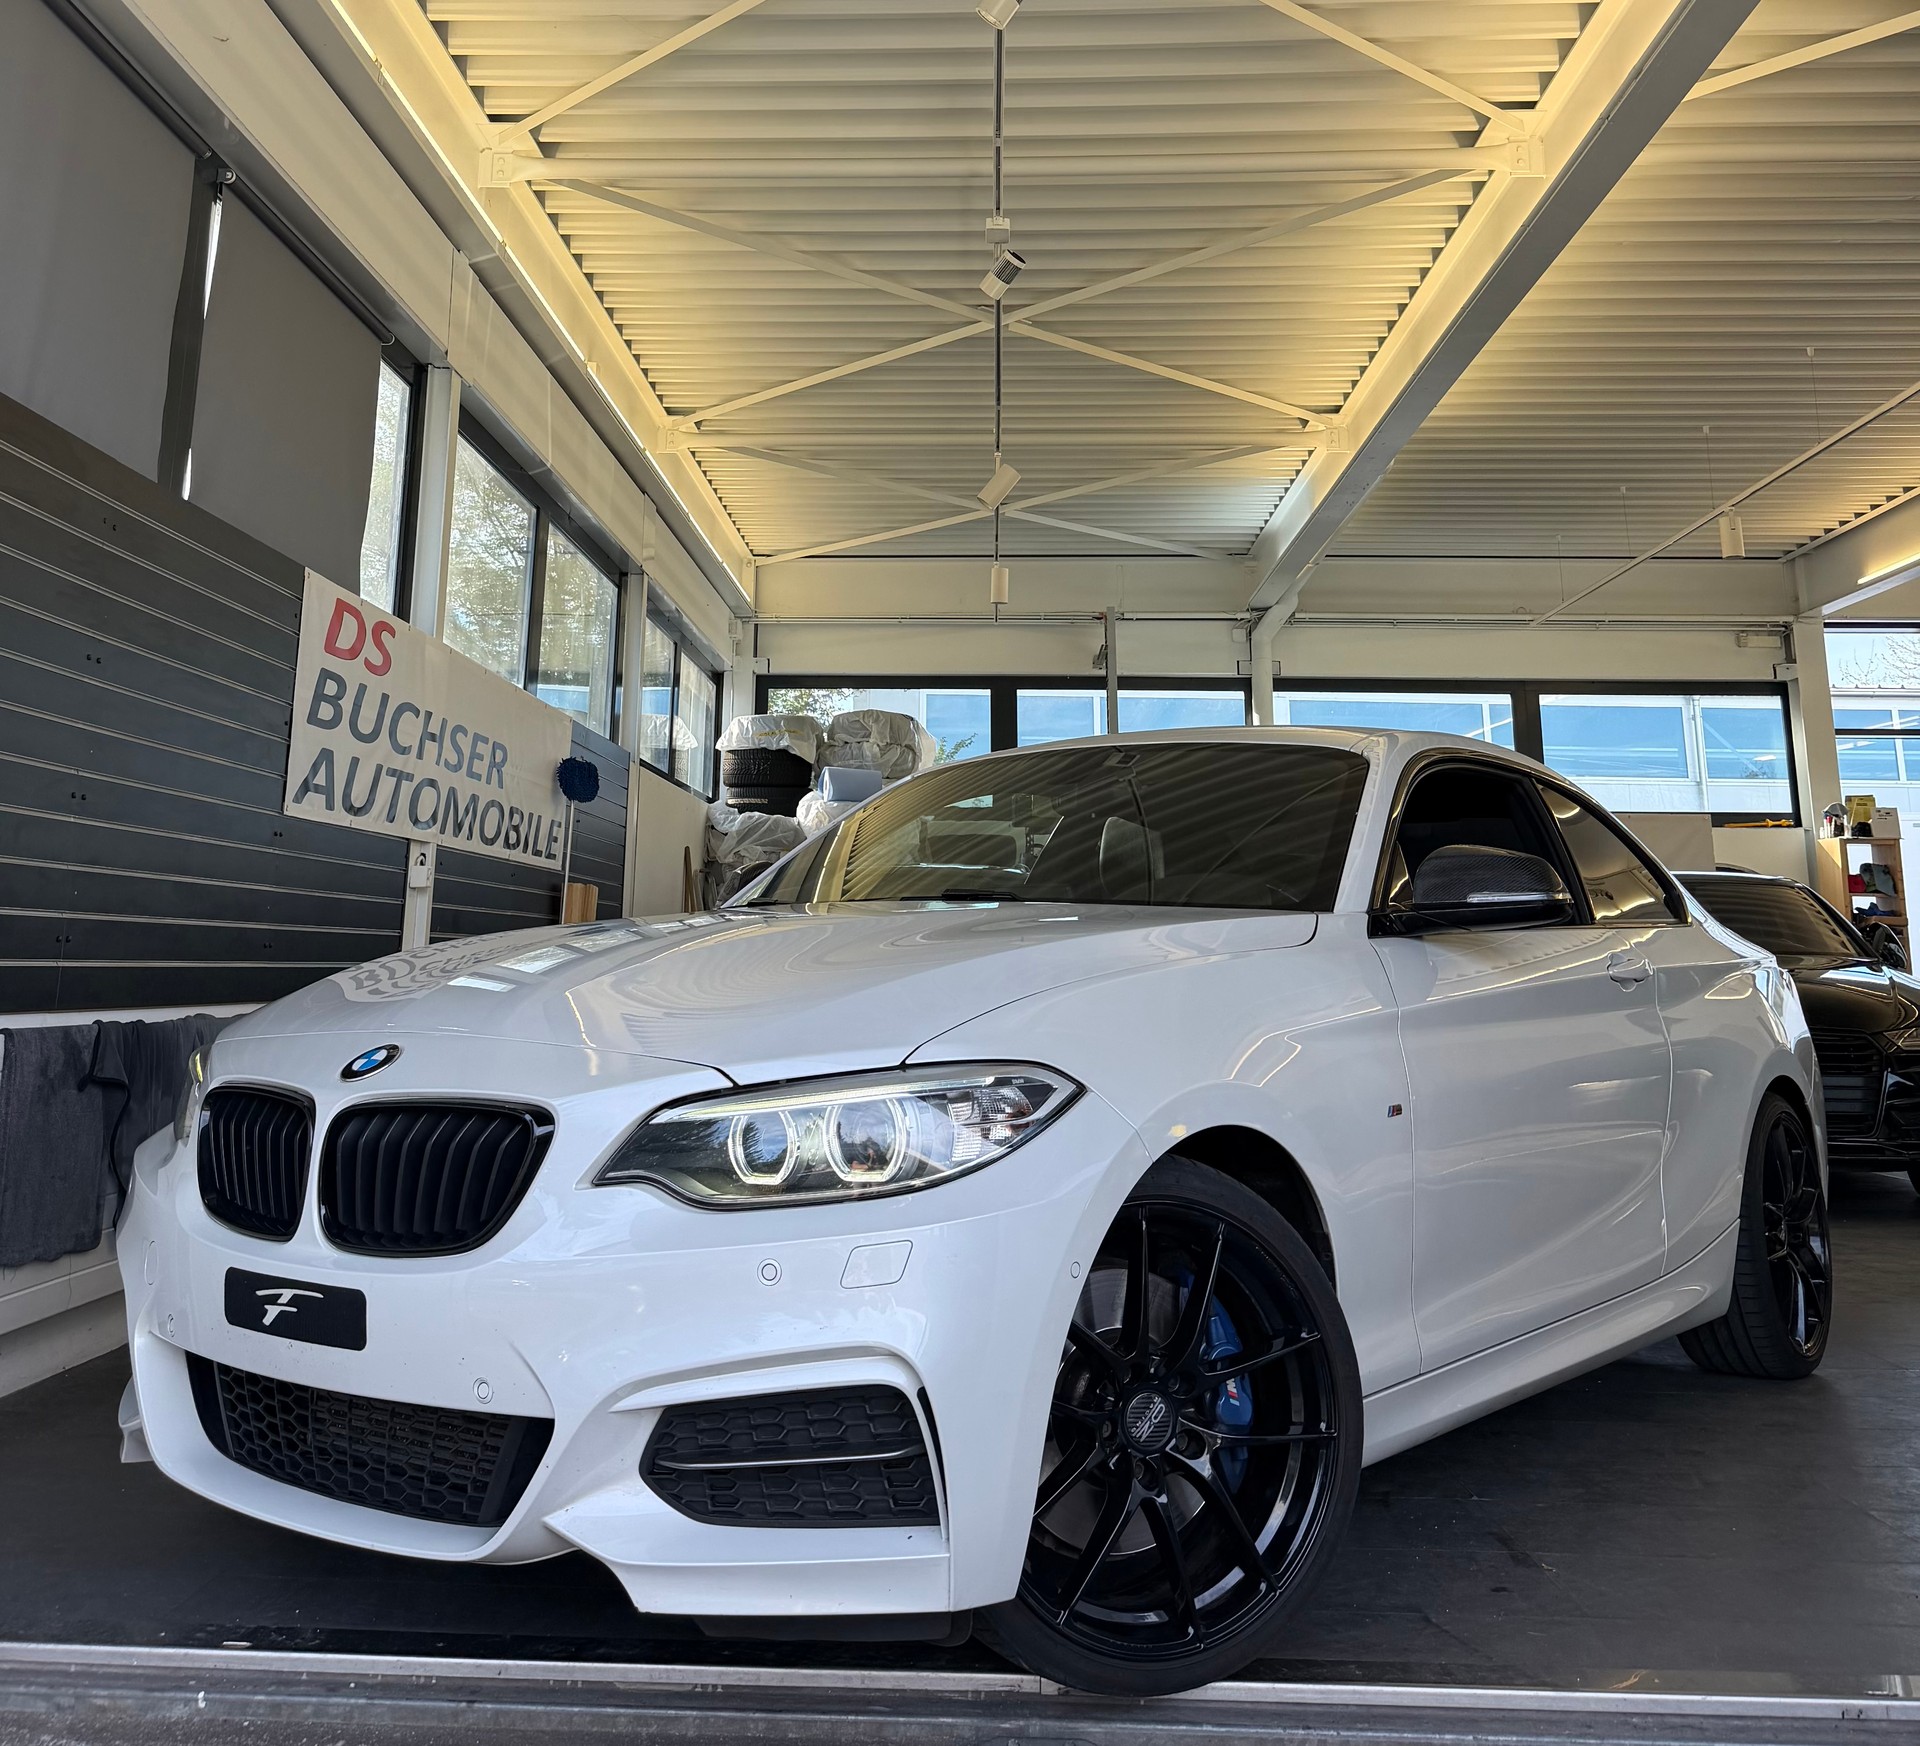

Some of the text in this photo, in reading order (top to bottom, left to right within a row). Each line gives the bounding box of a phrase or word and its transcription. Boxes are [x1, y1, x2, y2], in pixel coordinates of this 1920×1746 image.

[323, 597, 396, 677] DS
[306, 667, 509, 789] BUCHSER
[292, 747, 562, 861] AUTOMOBILE
